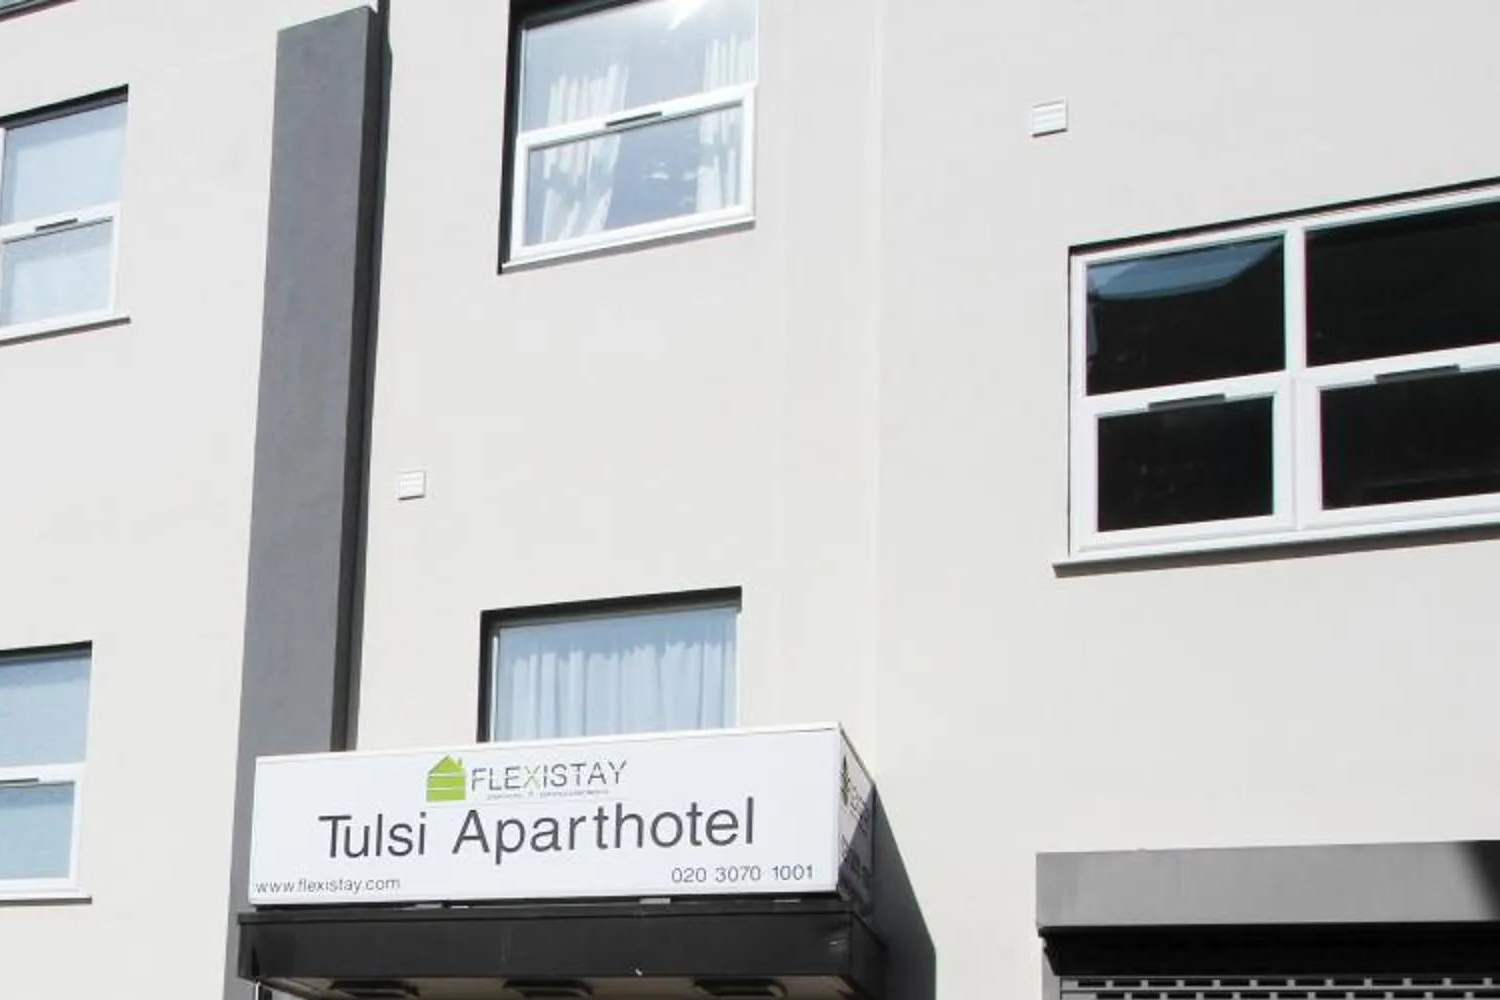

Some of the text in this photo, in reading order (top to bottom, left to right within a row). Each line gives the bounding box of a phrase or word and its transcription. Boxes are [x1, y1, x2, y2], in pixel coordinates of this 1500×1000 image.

[471, 760, 627, 792] FLEXISTAY
[318, 796, 755, 866] Tulsi Aparthotel
[255, 878, 401, 895] www.flexistay.com
[671, 863, 814, 884] 020 3070 1001
